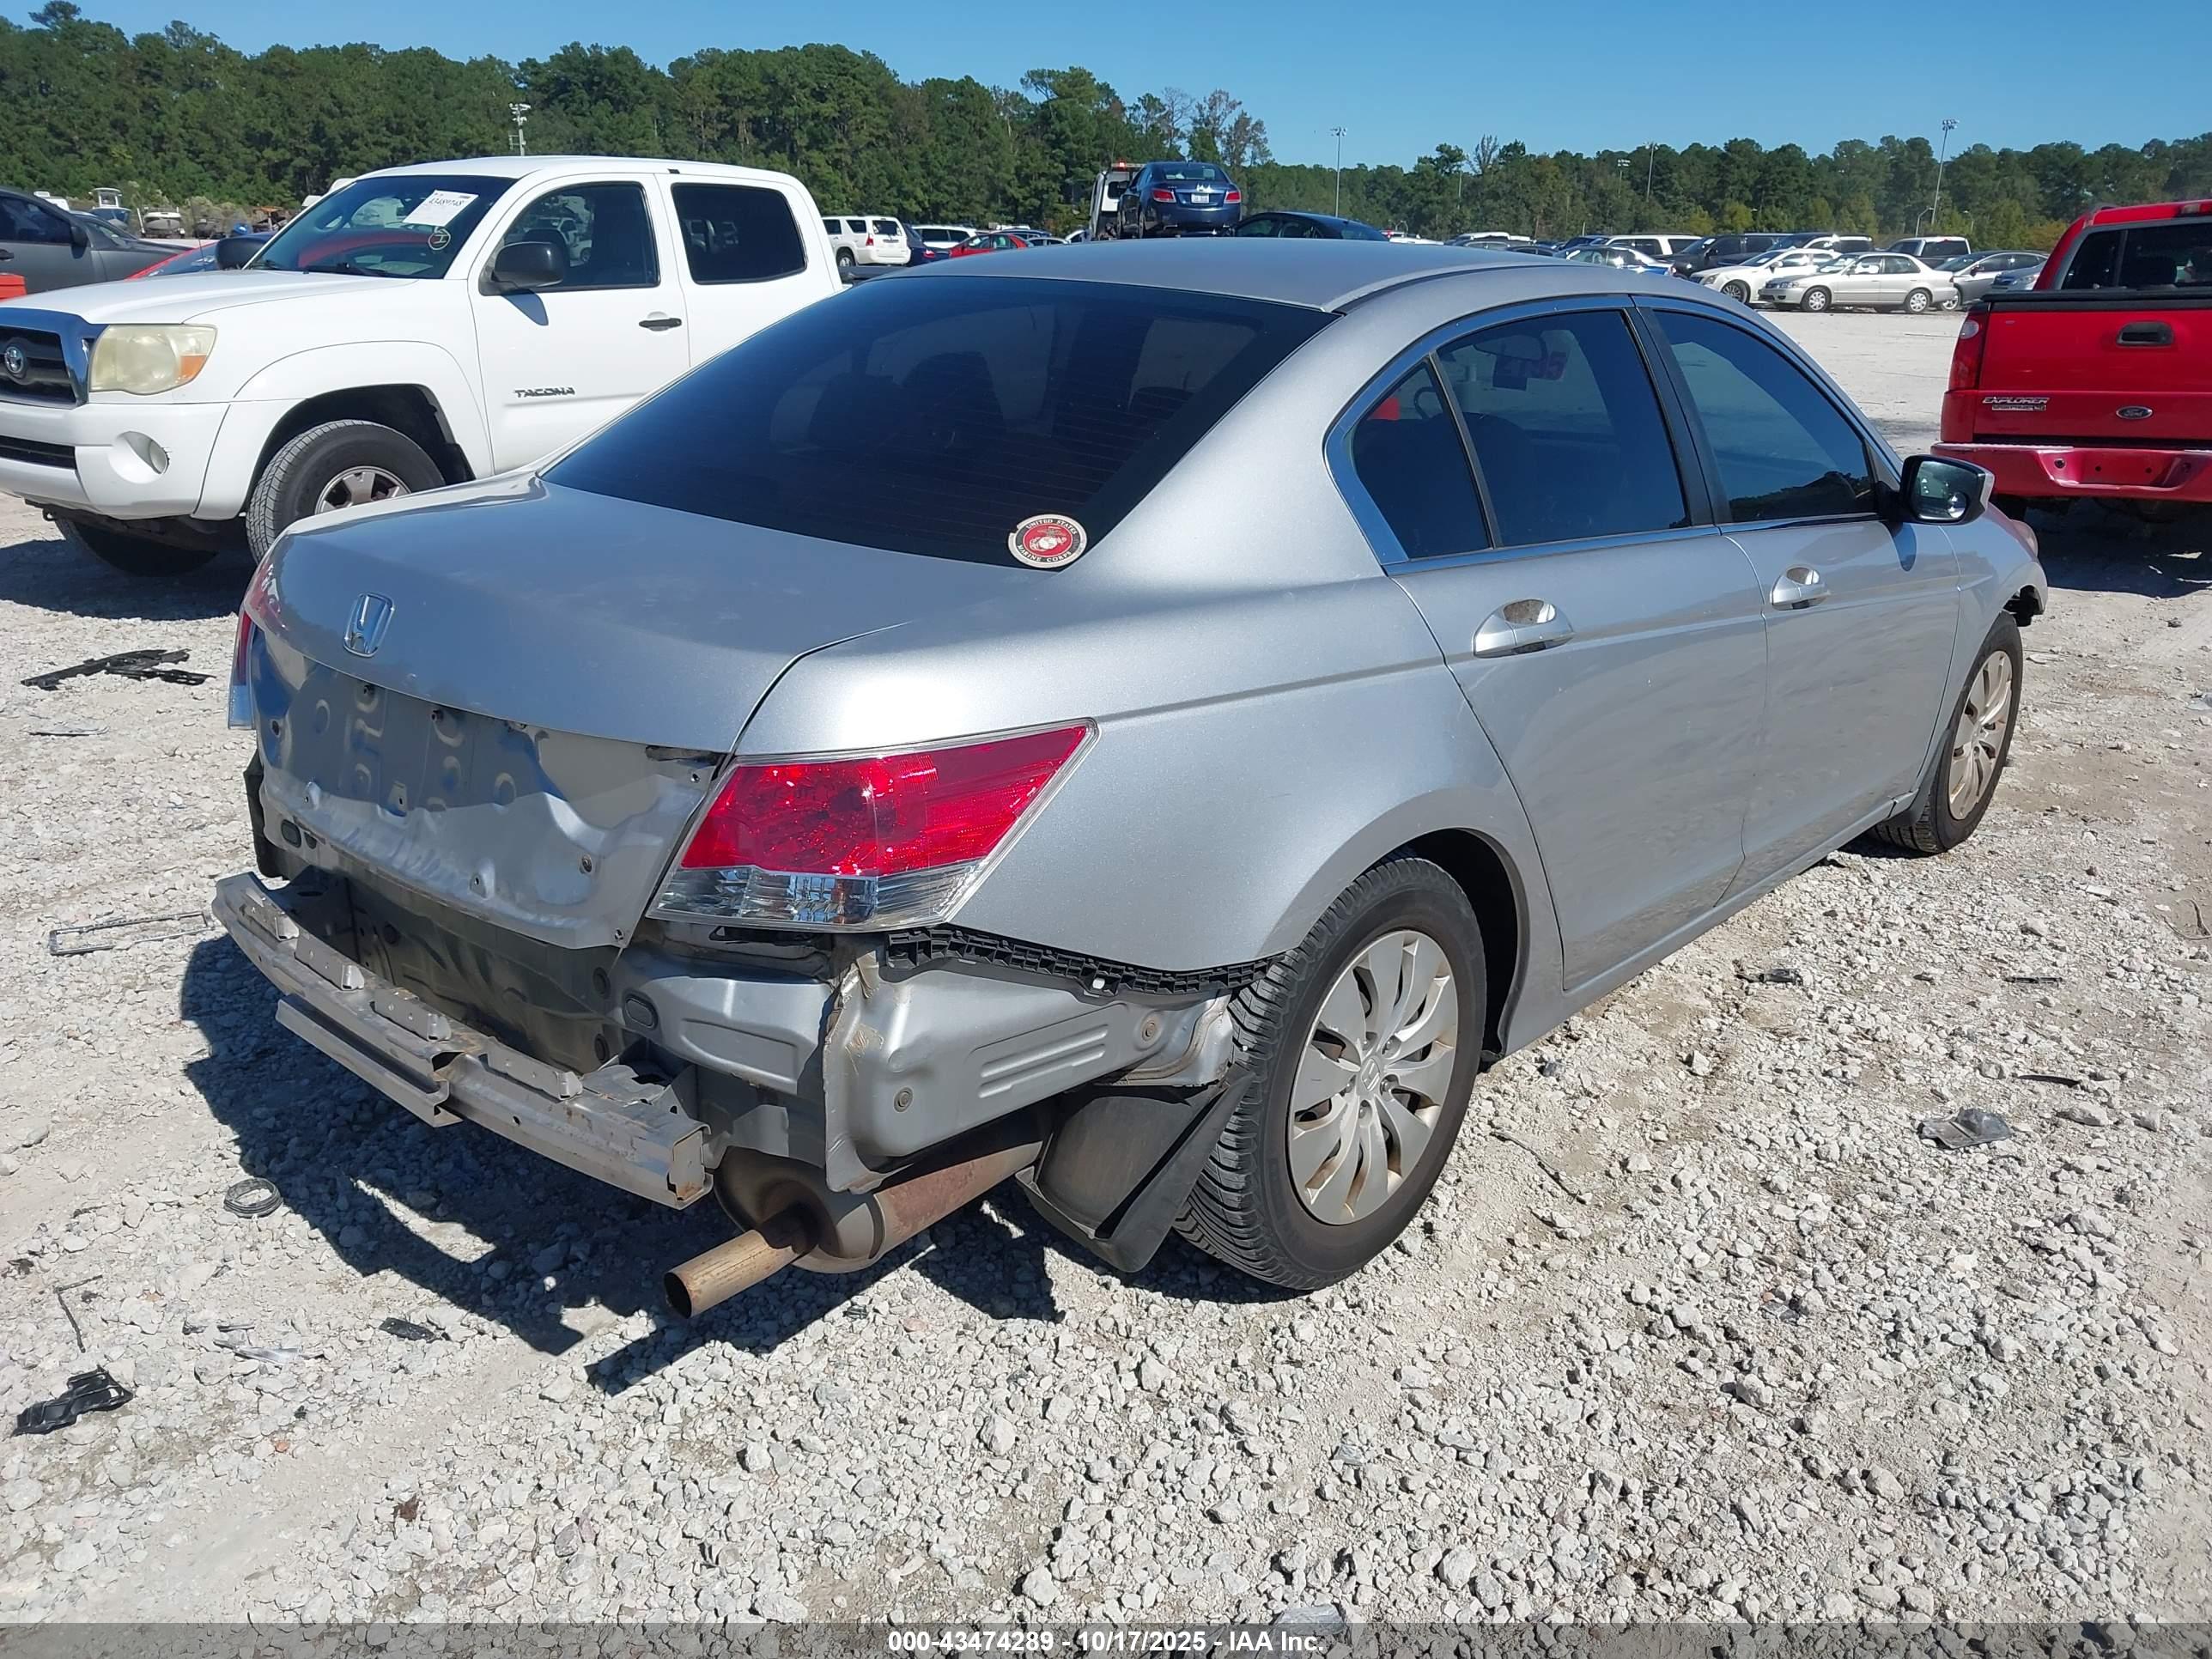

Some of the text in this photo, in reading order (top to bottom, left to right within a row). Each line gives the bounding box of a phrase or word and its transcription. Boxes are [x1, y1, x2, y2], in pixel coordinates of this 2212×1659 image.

[514, 387, 575, 398] TACOMA
[1025, 519, 1078, 535] UNITED STATES
[1017, 544, 1073, 562] MARINE CORPS
